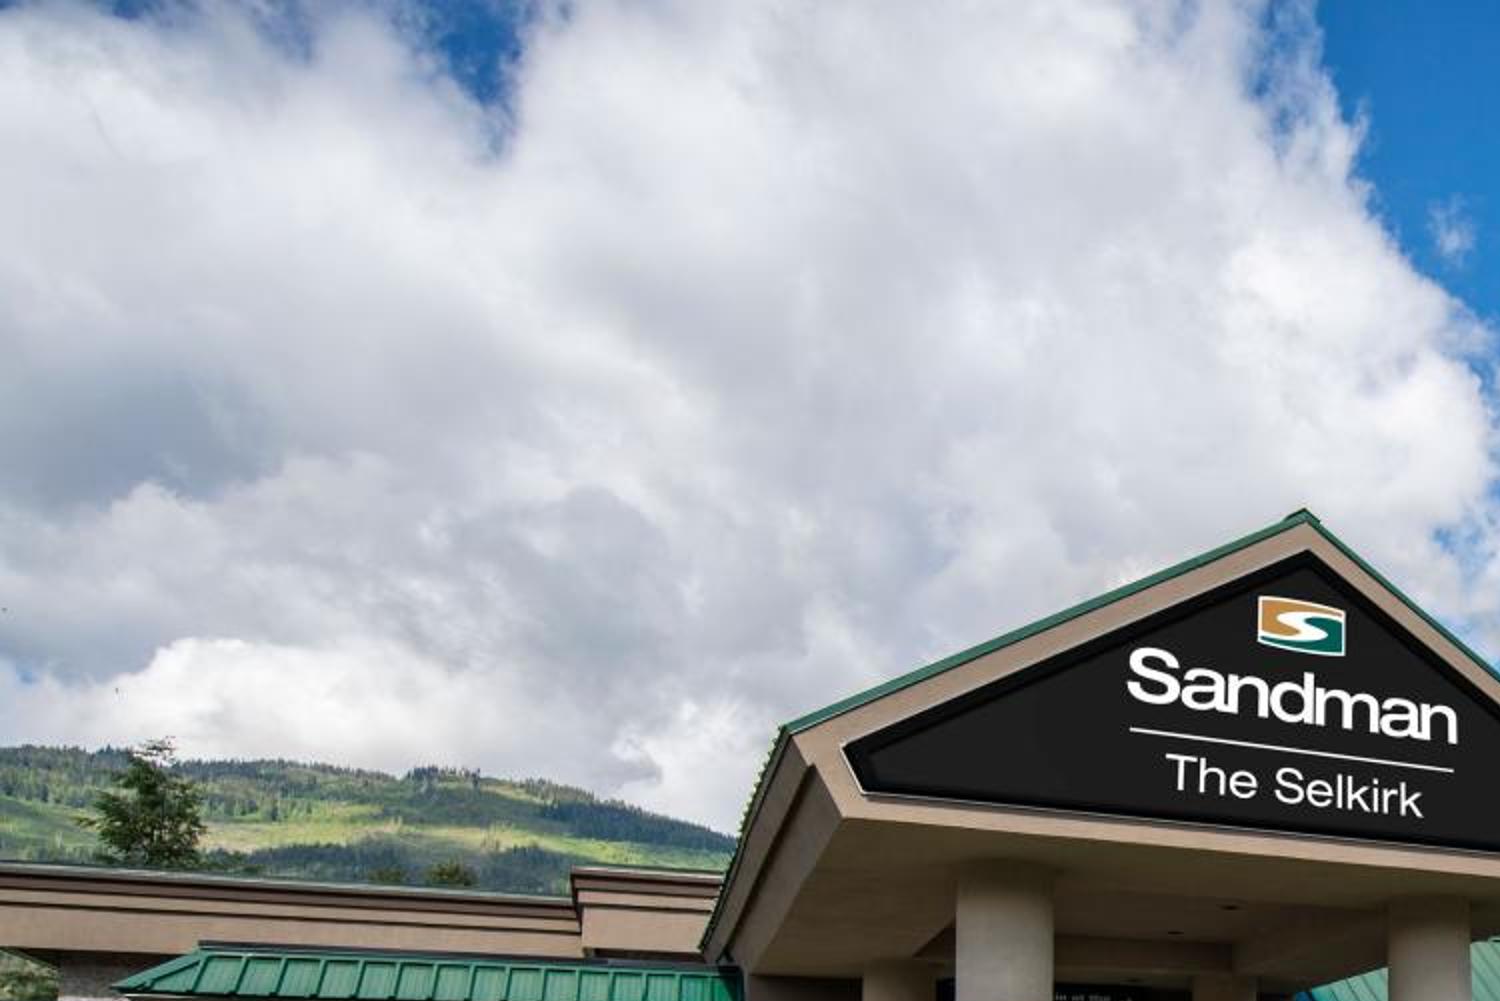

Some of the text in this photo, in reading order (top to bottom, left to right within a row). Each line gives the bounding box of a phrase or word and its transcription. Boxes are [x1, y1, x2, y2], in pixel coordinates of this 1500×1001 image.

[1127, 647, 1458, 745] Sandman
[1165, 753, 1424, 819] The Selkirk
